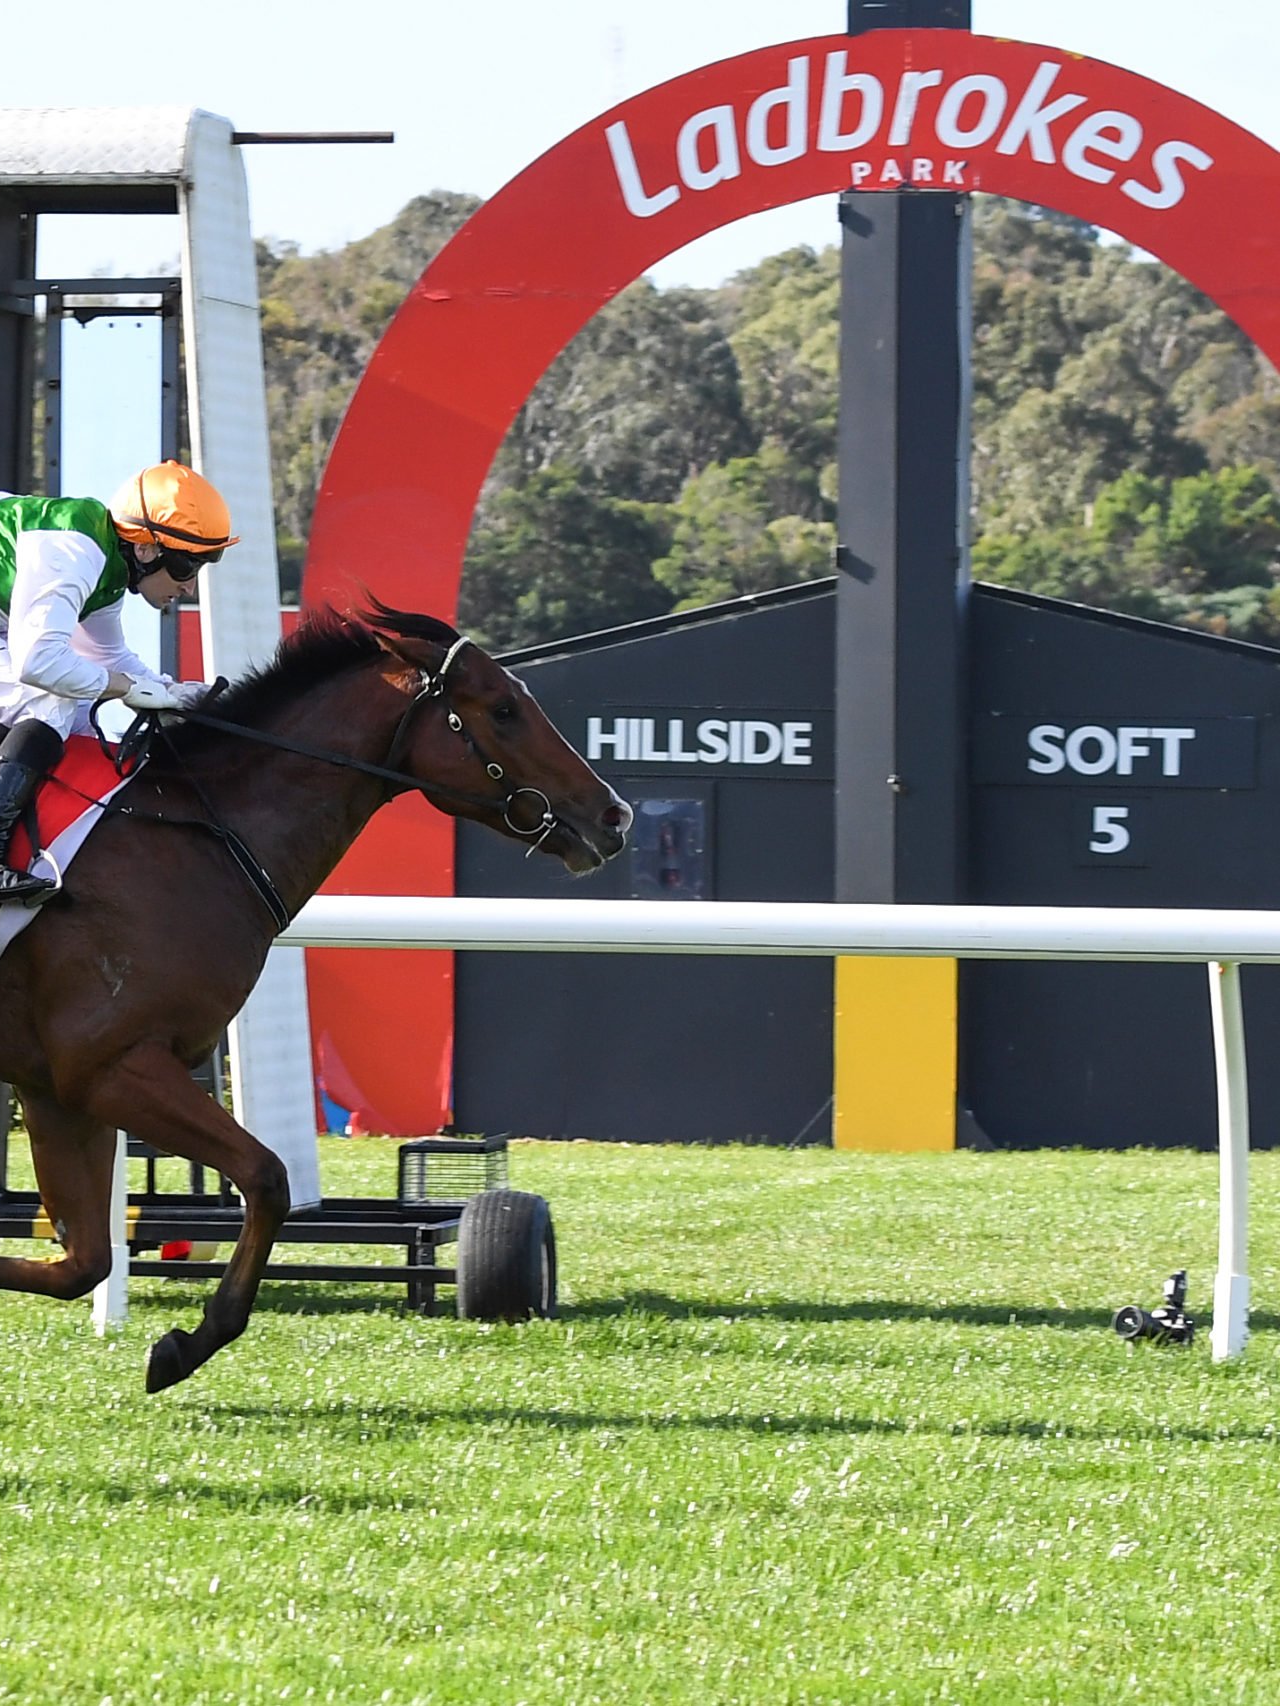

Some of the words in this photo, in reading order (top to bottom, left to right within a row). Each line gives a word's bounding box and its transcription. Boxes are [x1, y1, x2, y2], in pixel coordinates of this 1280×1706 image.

[605, 50, 1214, 218] Ladbrokes
[850, 158, 967, 186] PARK
[587, 717, 813, 766] HILLSIDE
[1028, 725, 1196, 776] SOFT
[1090, 806, 1130, 854] 5
